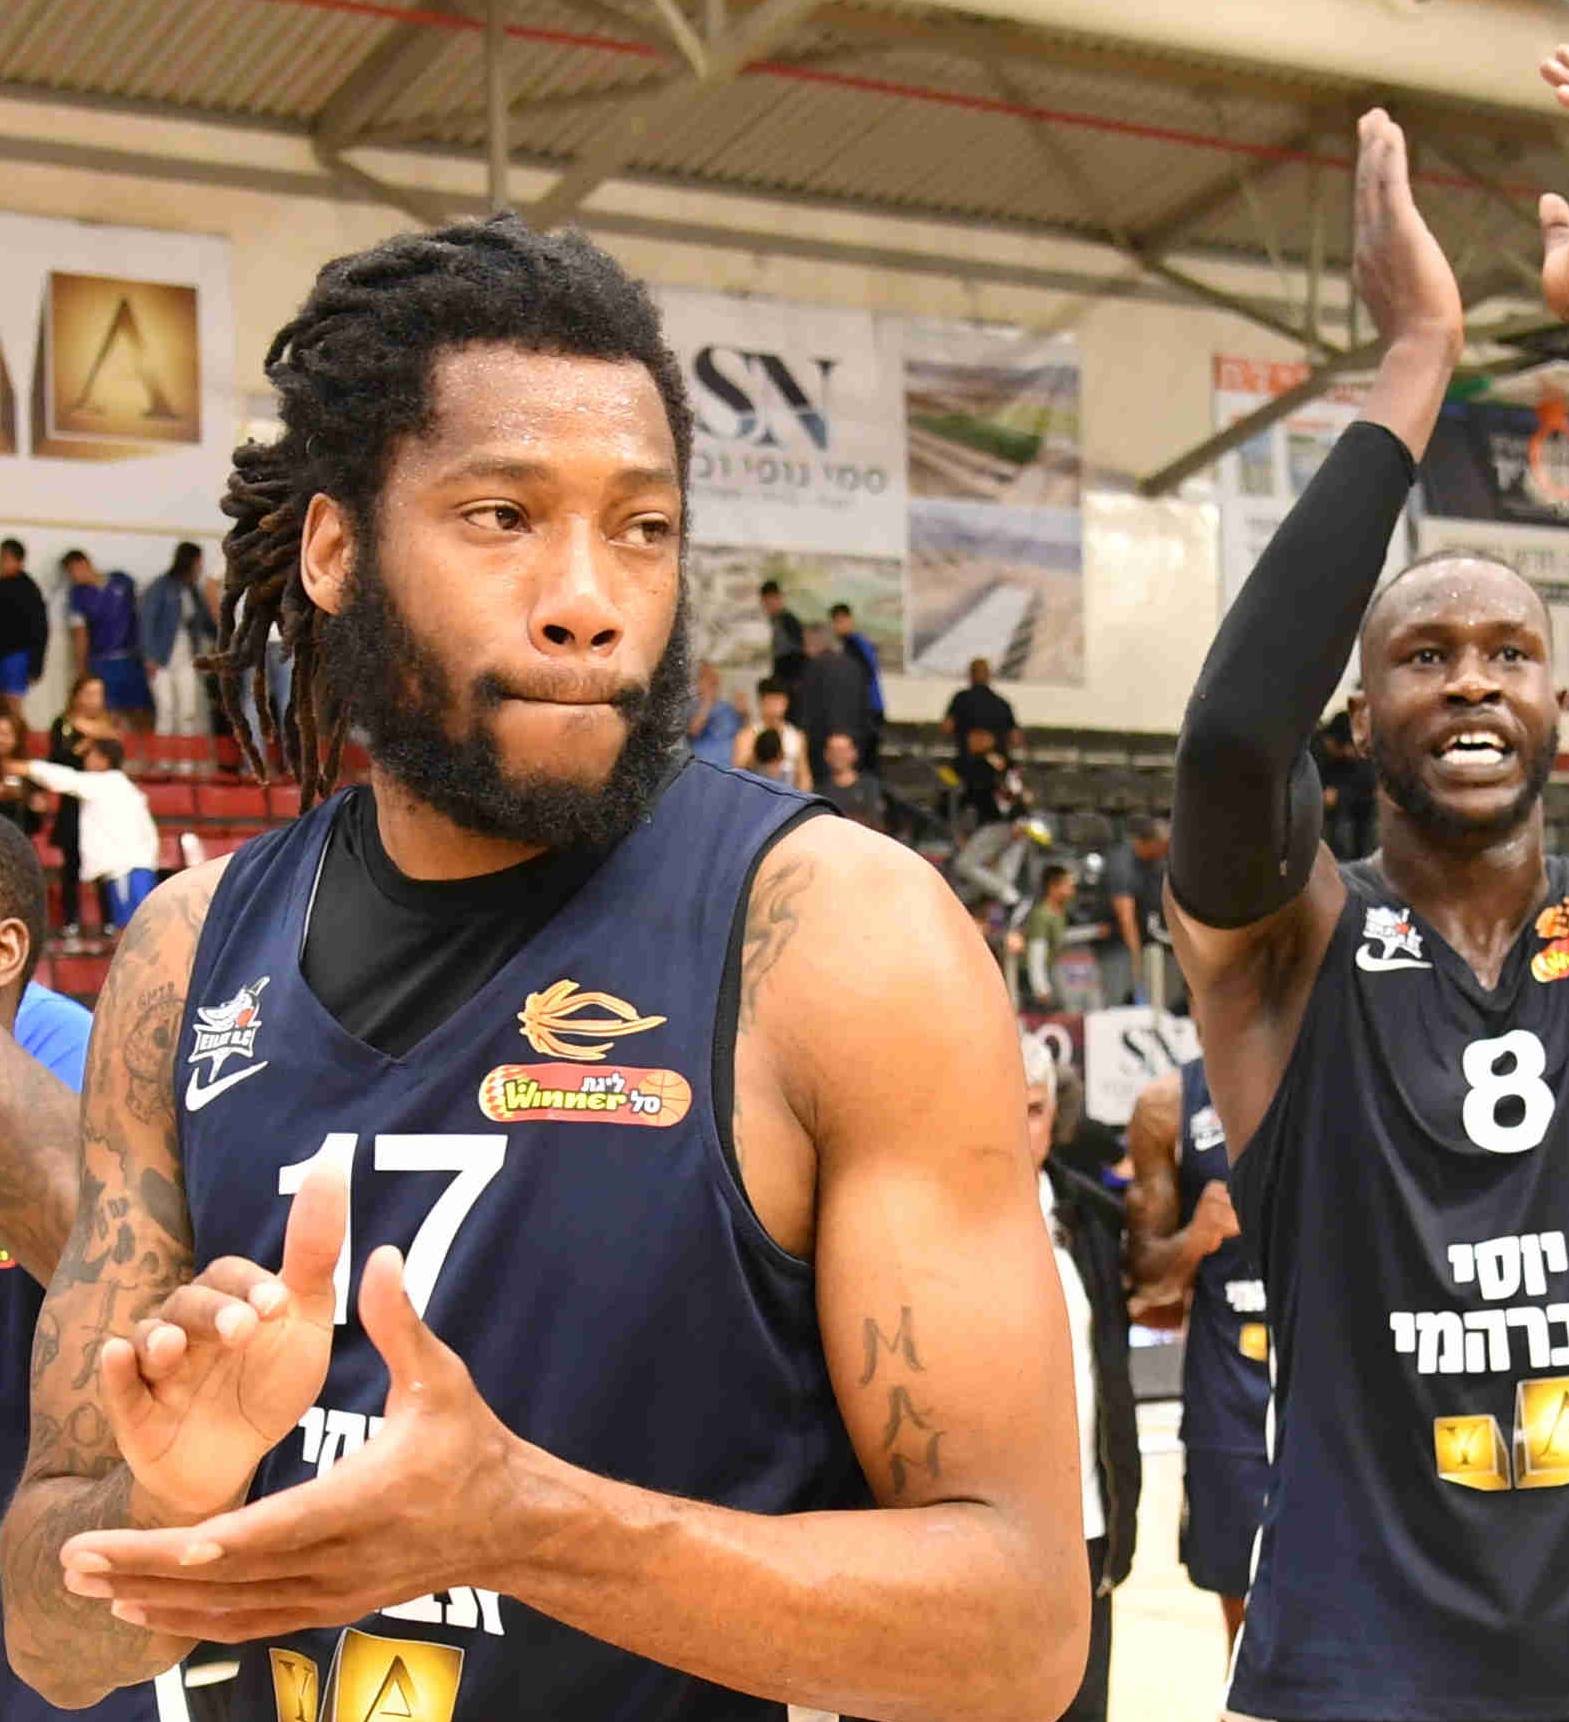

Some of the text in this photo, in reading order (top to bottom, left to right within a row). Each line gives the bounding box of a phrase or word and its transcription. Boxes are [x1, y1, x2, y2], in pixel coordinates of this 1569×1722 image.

[693, 345, 840, 452] SN
[504, 1080, 662, 1113] Winner סל
[1462, 1029, 1555, 1153] 8
[278, 1133, 508, 1325] 17
[1447, 1230, 1568, 1300] יוסי
